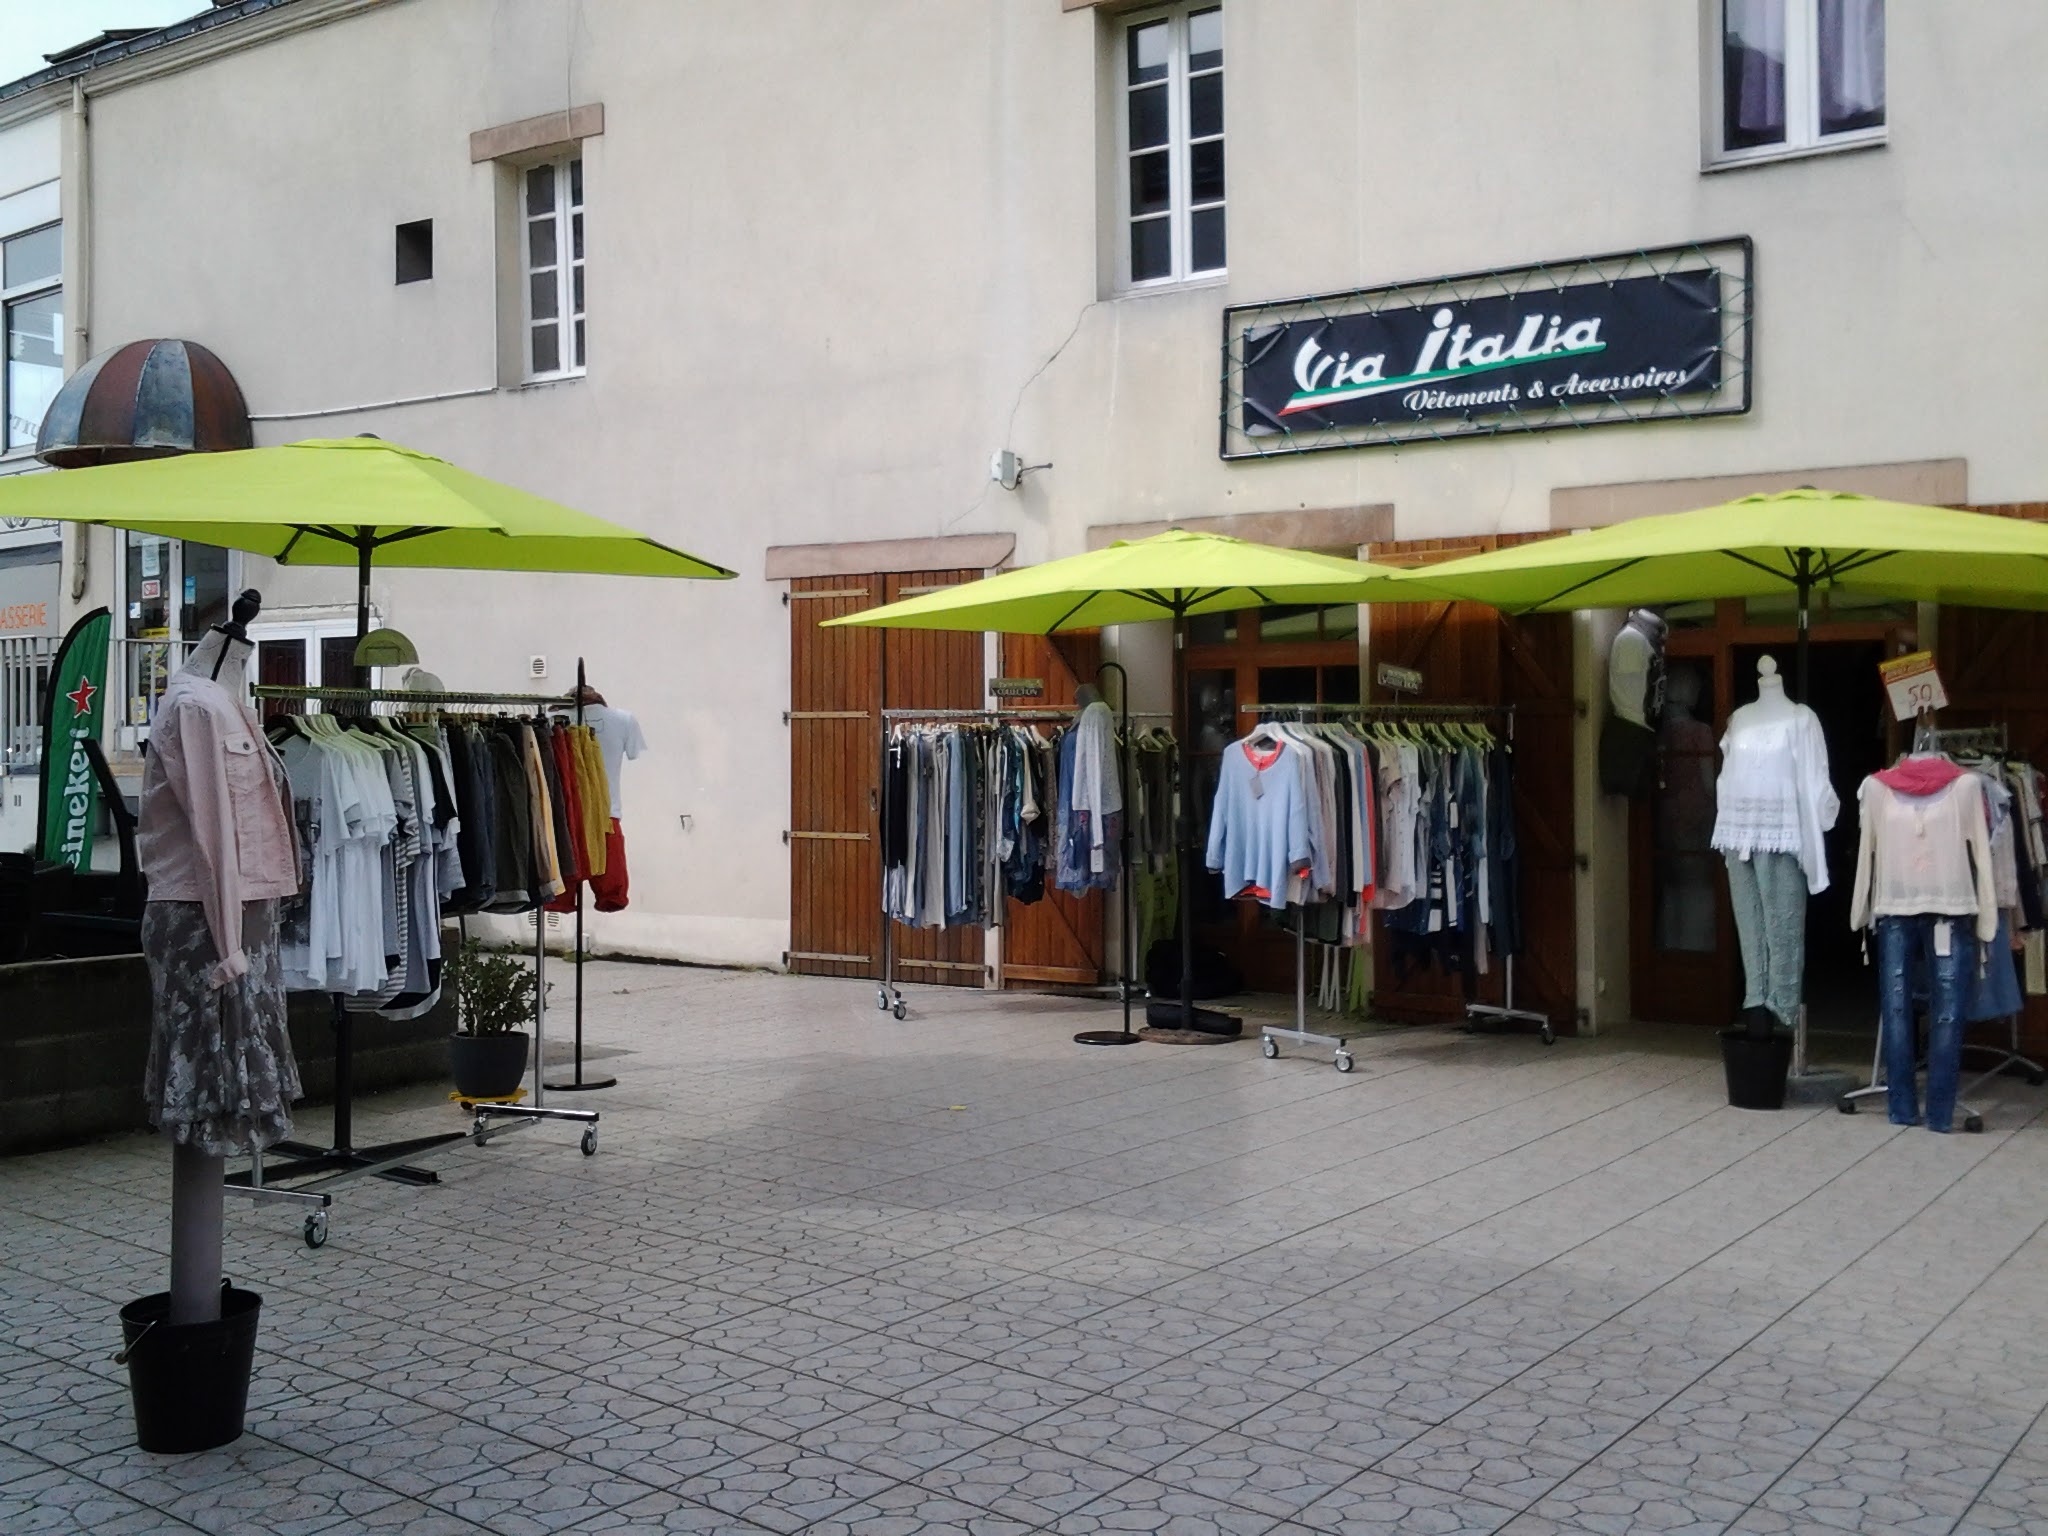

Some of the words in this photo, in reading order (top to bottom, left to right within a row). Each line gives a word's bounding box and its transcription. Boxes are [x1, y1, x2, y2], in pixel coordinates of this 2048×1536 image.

[1293, 336, 1387, 392] Via
[1412, 308, 1606, 377] Italia
[1403, 384, 1520, 411] Vêtements
[1527, 381, 1544, 398] &
[1550, 369, 1688, 399] Accessoires
[61, 726, 90, 870] eineken
